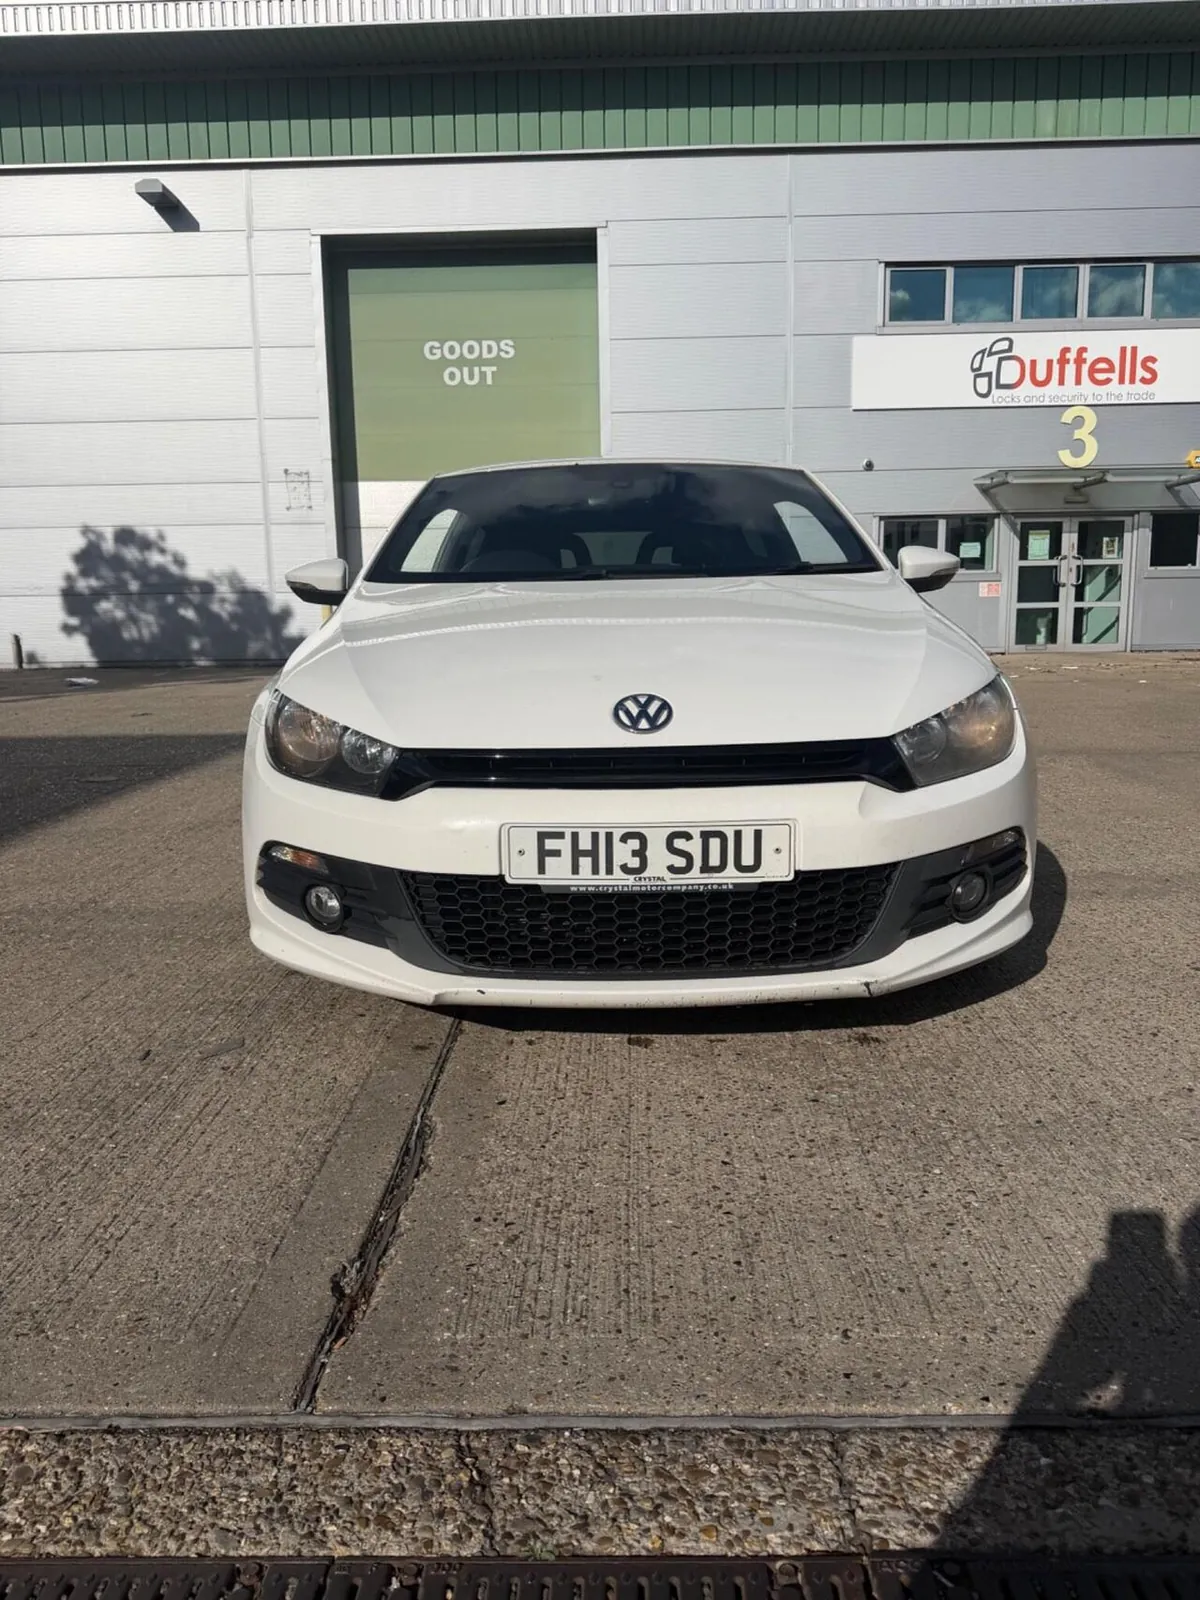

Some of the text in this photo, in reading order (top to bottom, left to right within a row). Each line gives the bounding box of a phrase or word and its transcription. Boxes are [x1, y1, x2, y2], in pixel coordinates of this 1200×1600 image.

[423, 339, 516, 361] GOODS
[443, 366, 498, 386] OUT
[995, 346, 1159, 390] Duffells
[992, 390, 1156, 404] Locks and security to the trade
[1057, 405, 1099, 469] 3
[536, 828, 763, 876] FH13 SDU
[570, 882, 734, 893] www.crystalmotorcompany.co.uk
